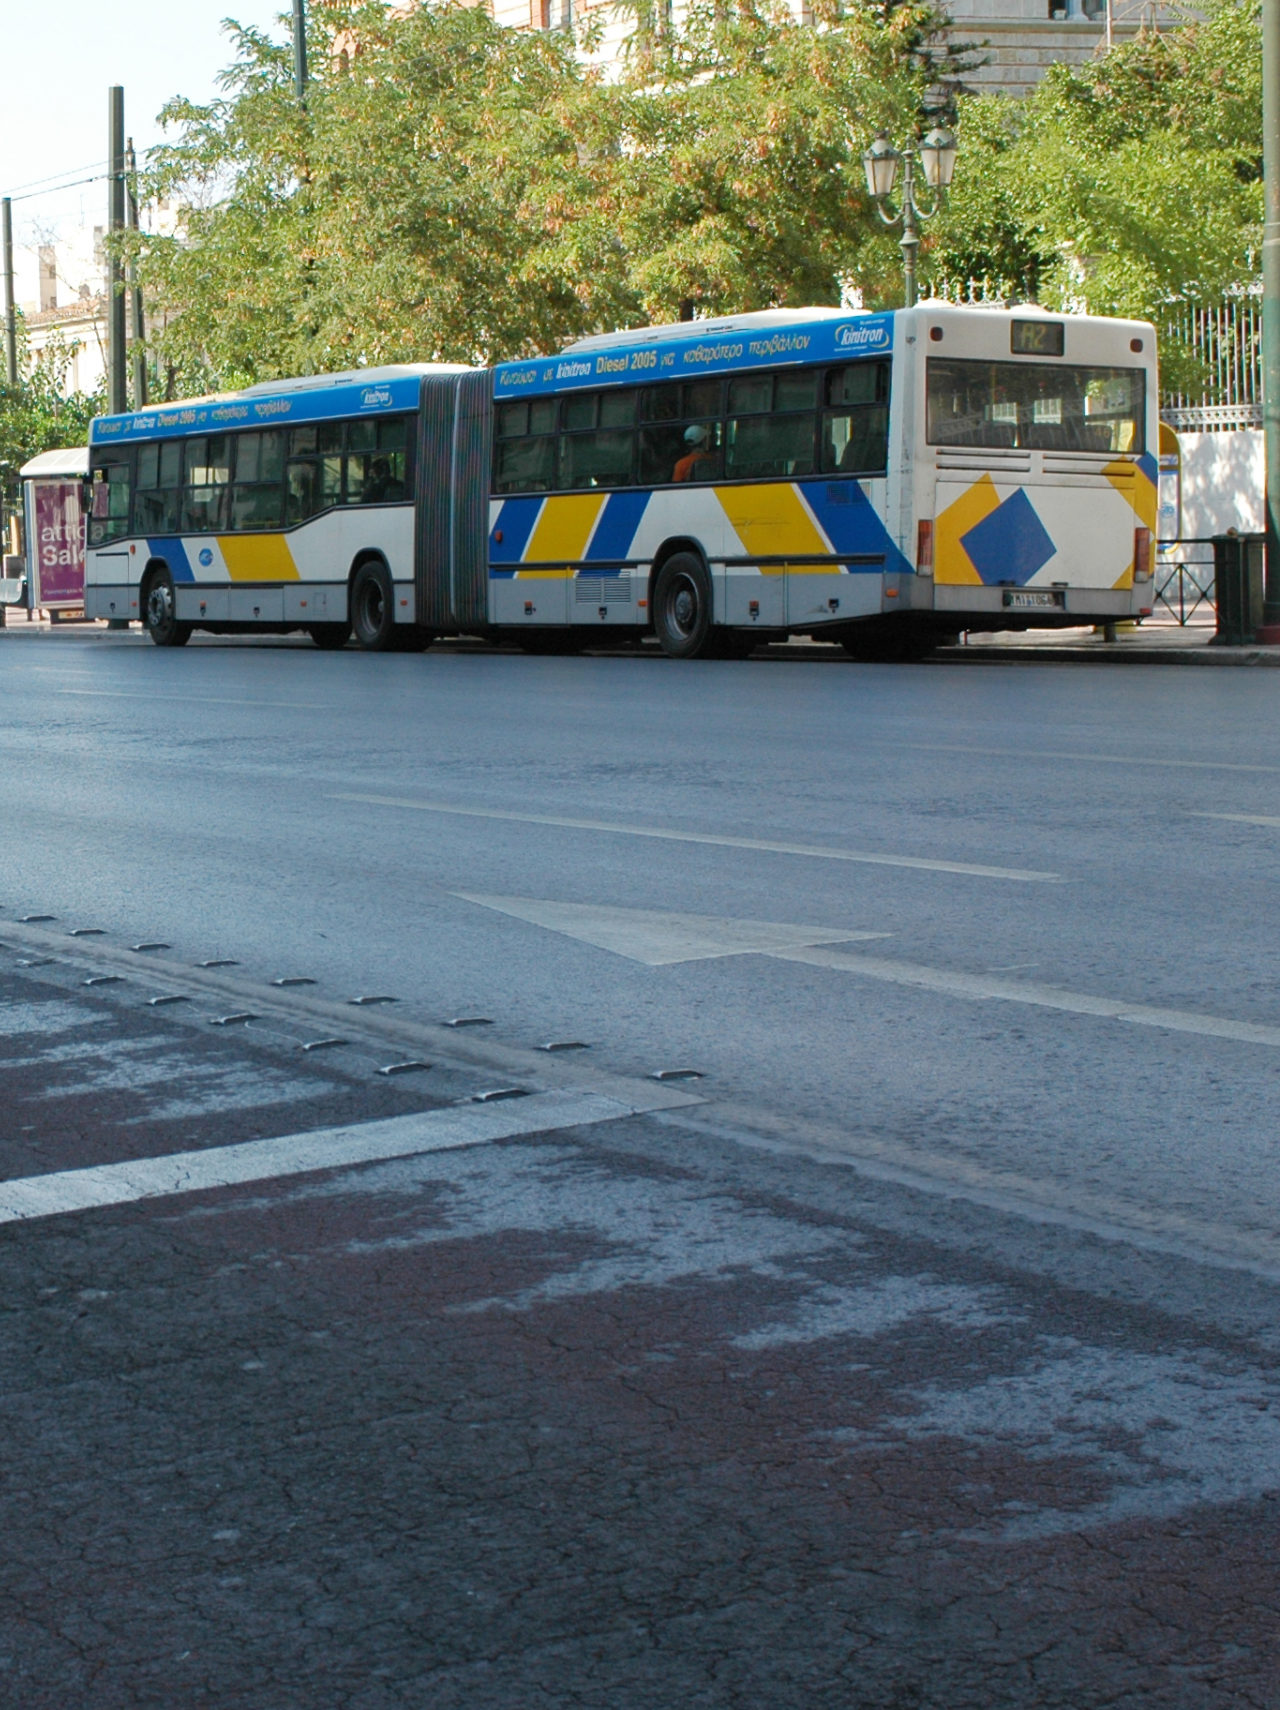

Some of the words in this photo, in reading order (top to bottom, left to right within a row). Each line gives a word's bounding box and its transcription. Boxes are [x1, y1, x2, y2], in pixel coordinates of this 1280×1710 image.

[841, 327, 883, 345] kinitron
[556, 361, 591, 379] kinitron
[596, 353, 629, 374] Diesel
[631, 350, 657, 369] 2005
